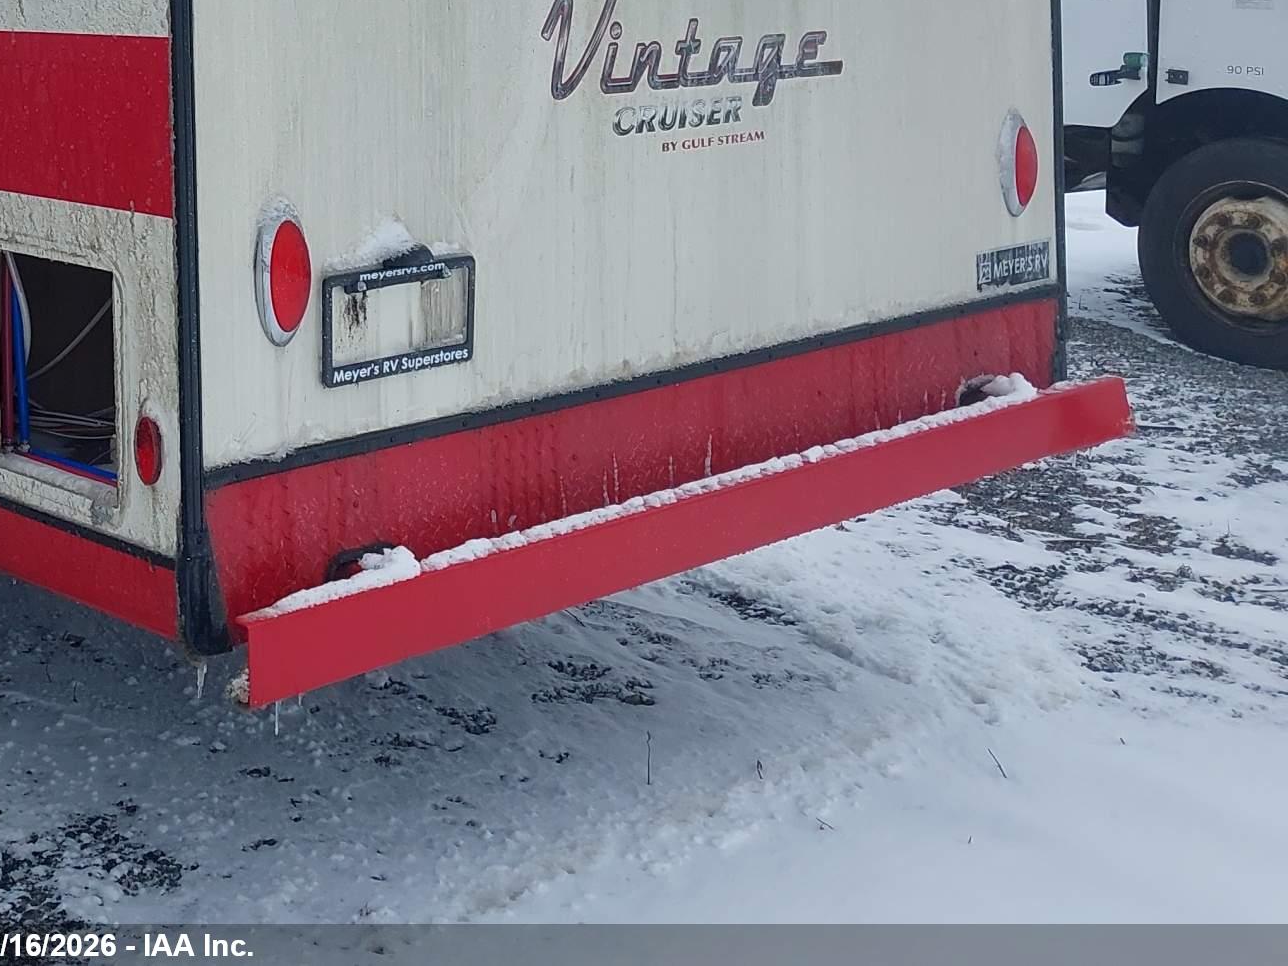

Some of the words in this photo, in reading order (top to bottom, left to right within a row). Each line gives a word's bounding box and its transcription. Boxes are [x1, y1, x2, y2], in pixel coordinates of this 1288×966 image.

[613, 96, 742, 136] CRUISER
[662, 140, 678, 153] BY
[681, 136, 714, 151] GULF
[717, 131, 765, 146] STREAM
[359, 262, 445, 281] meyersrvs.com
[993, 256, 1032, 279] MEYER'S
[333, 364, 379, 384] Meyer's
[382, 359, 400, 374] RV
[401, 348, 469, 372] Superstores
